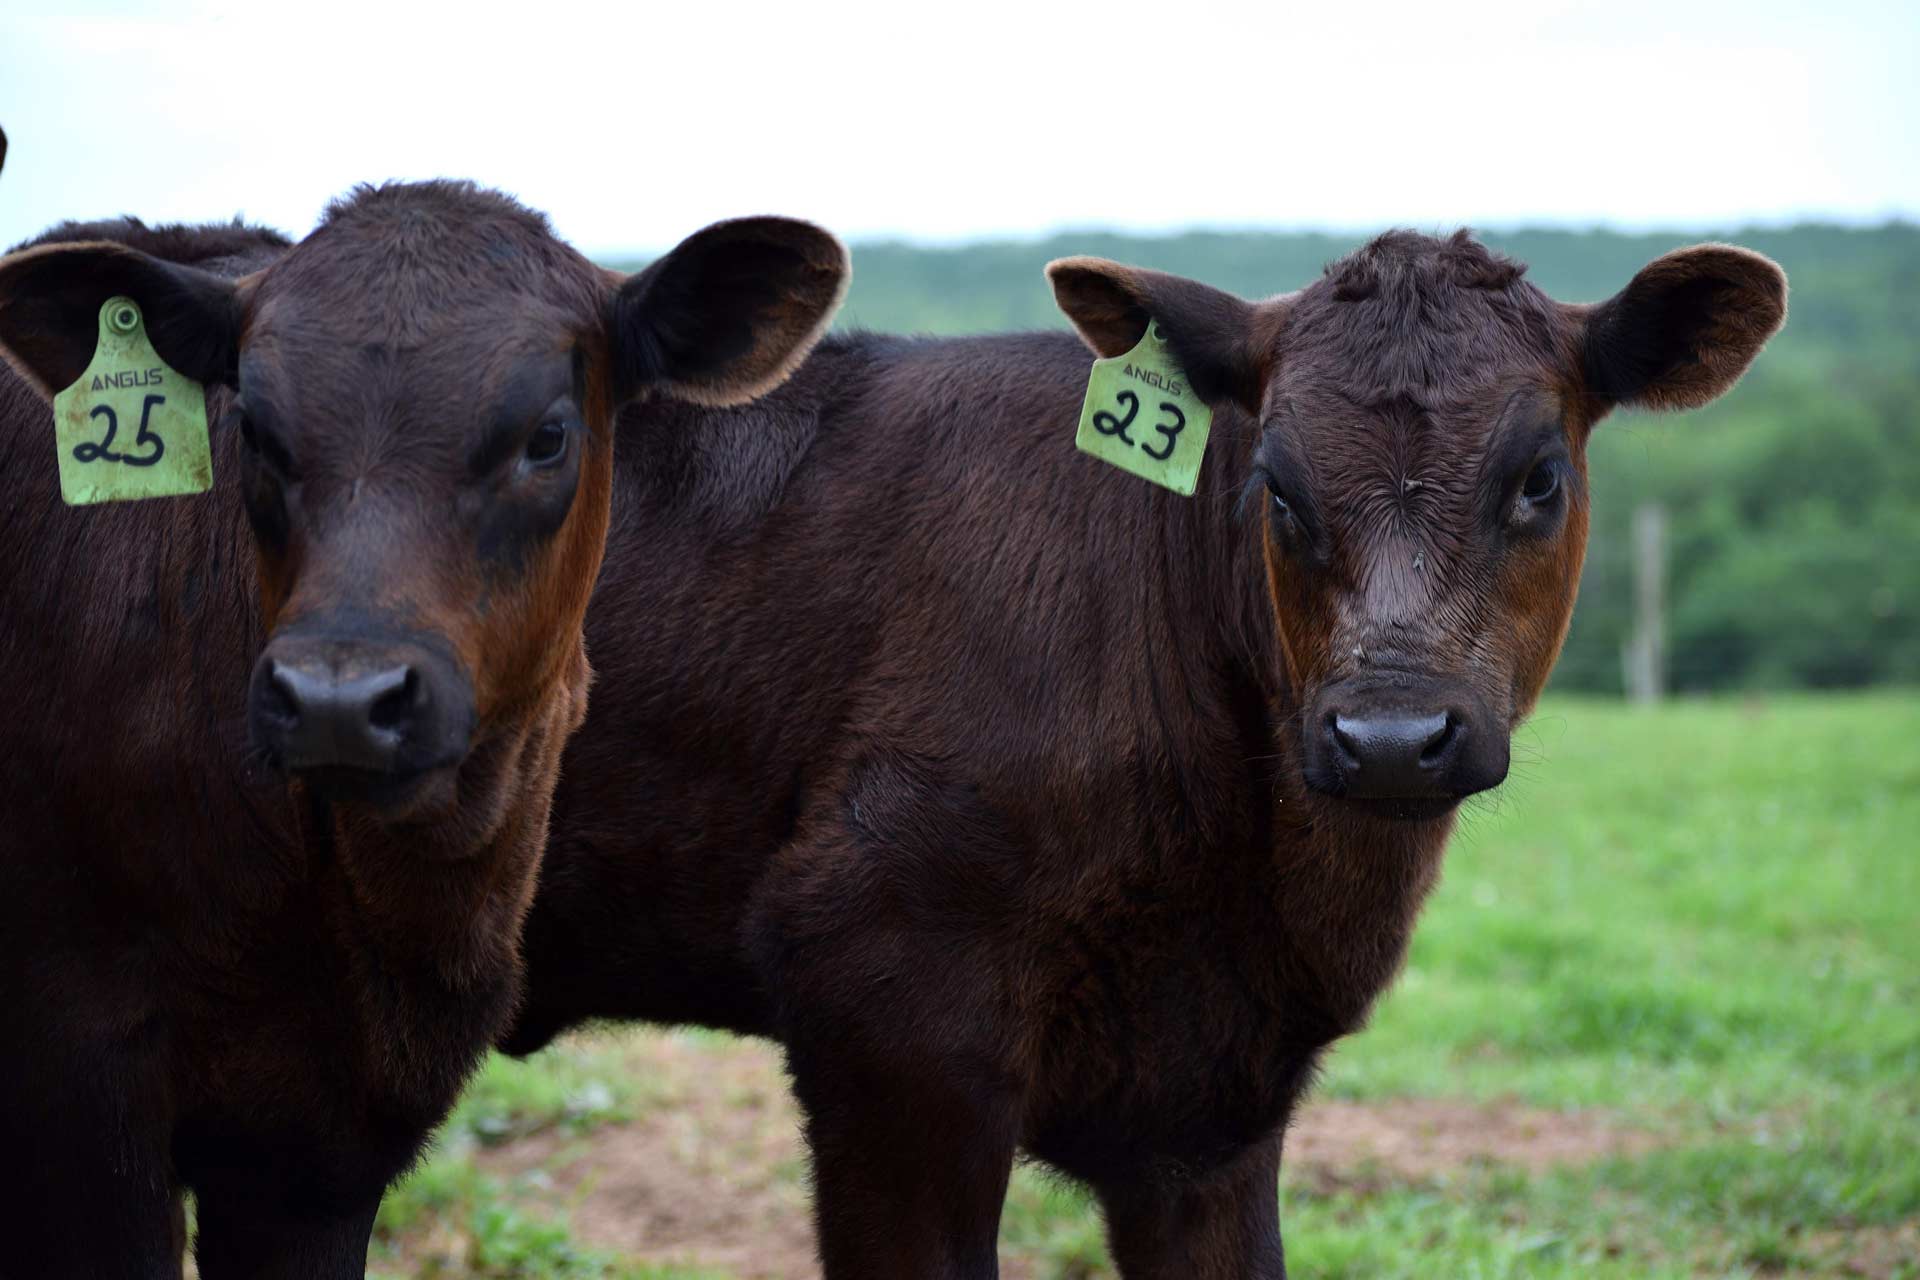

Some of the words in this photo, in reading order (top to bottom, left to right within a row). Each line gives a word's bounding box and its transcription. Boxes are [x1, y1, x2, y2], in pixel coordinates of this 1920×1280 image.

[91, 368, 163, 391] ANGUS
[1123, 363, 1183, 396] ANGUS
[73, 394, 165, 467] 25
[1093, 389, 1186, 460] 23
